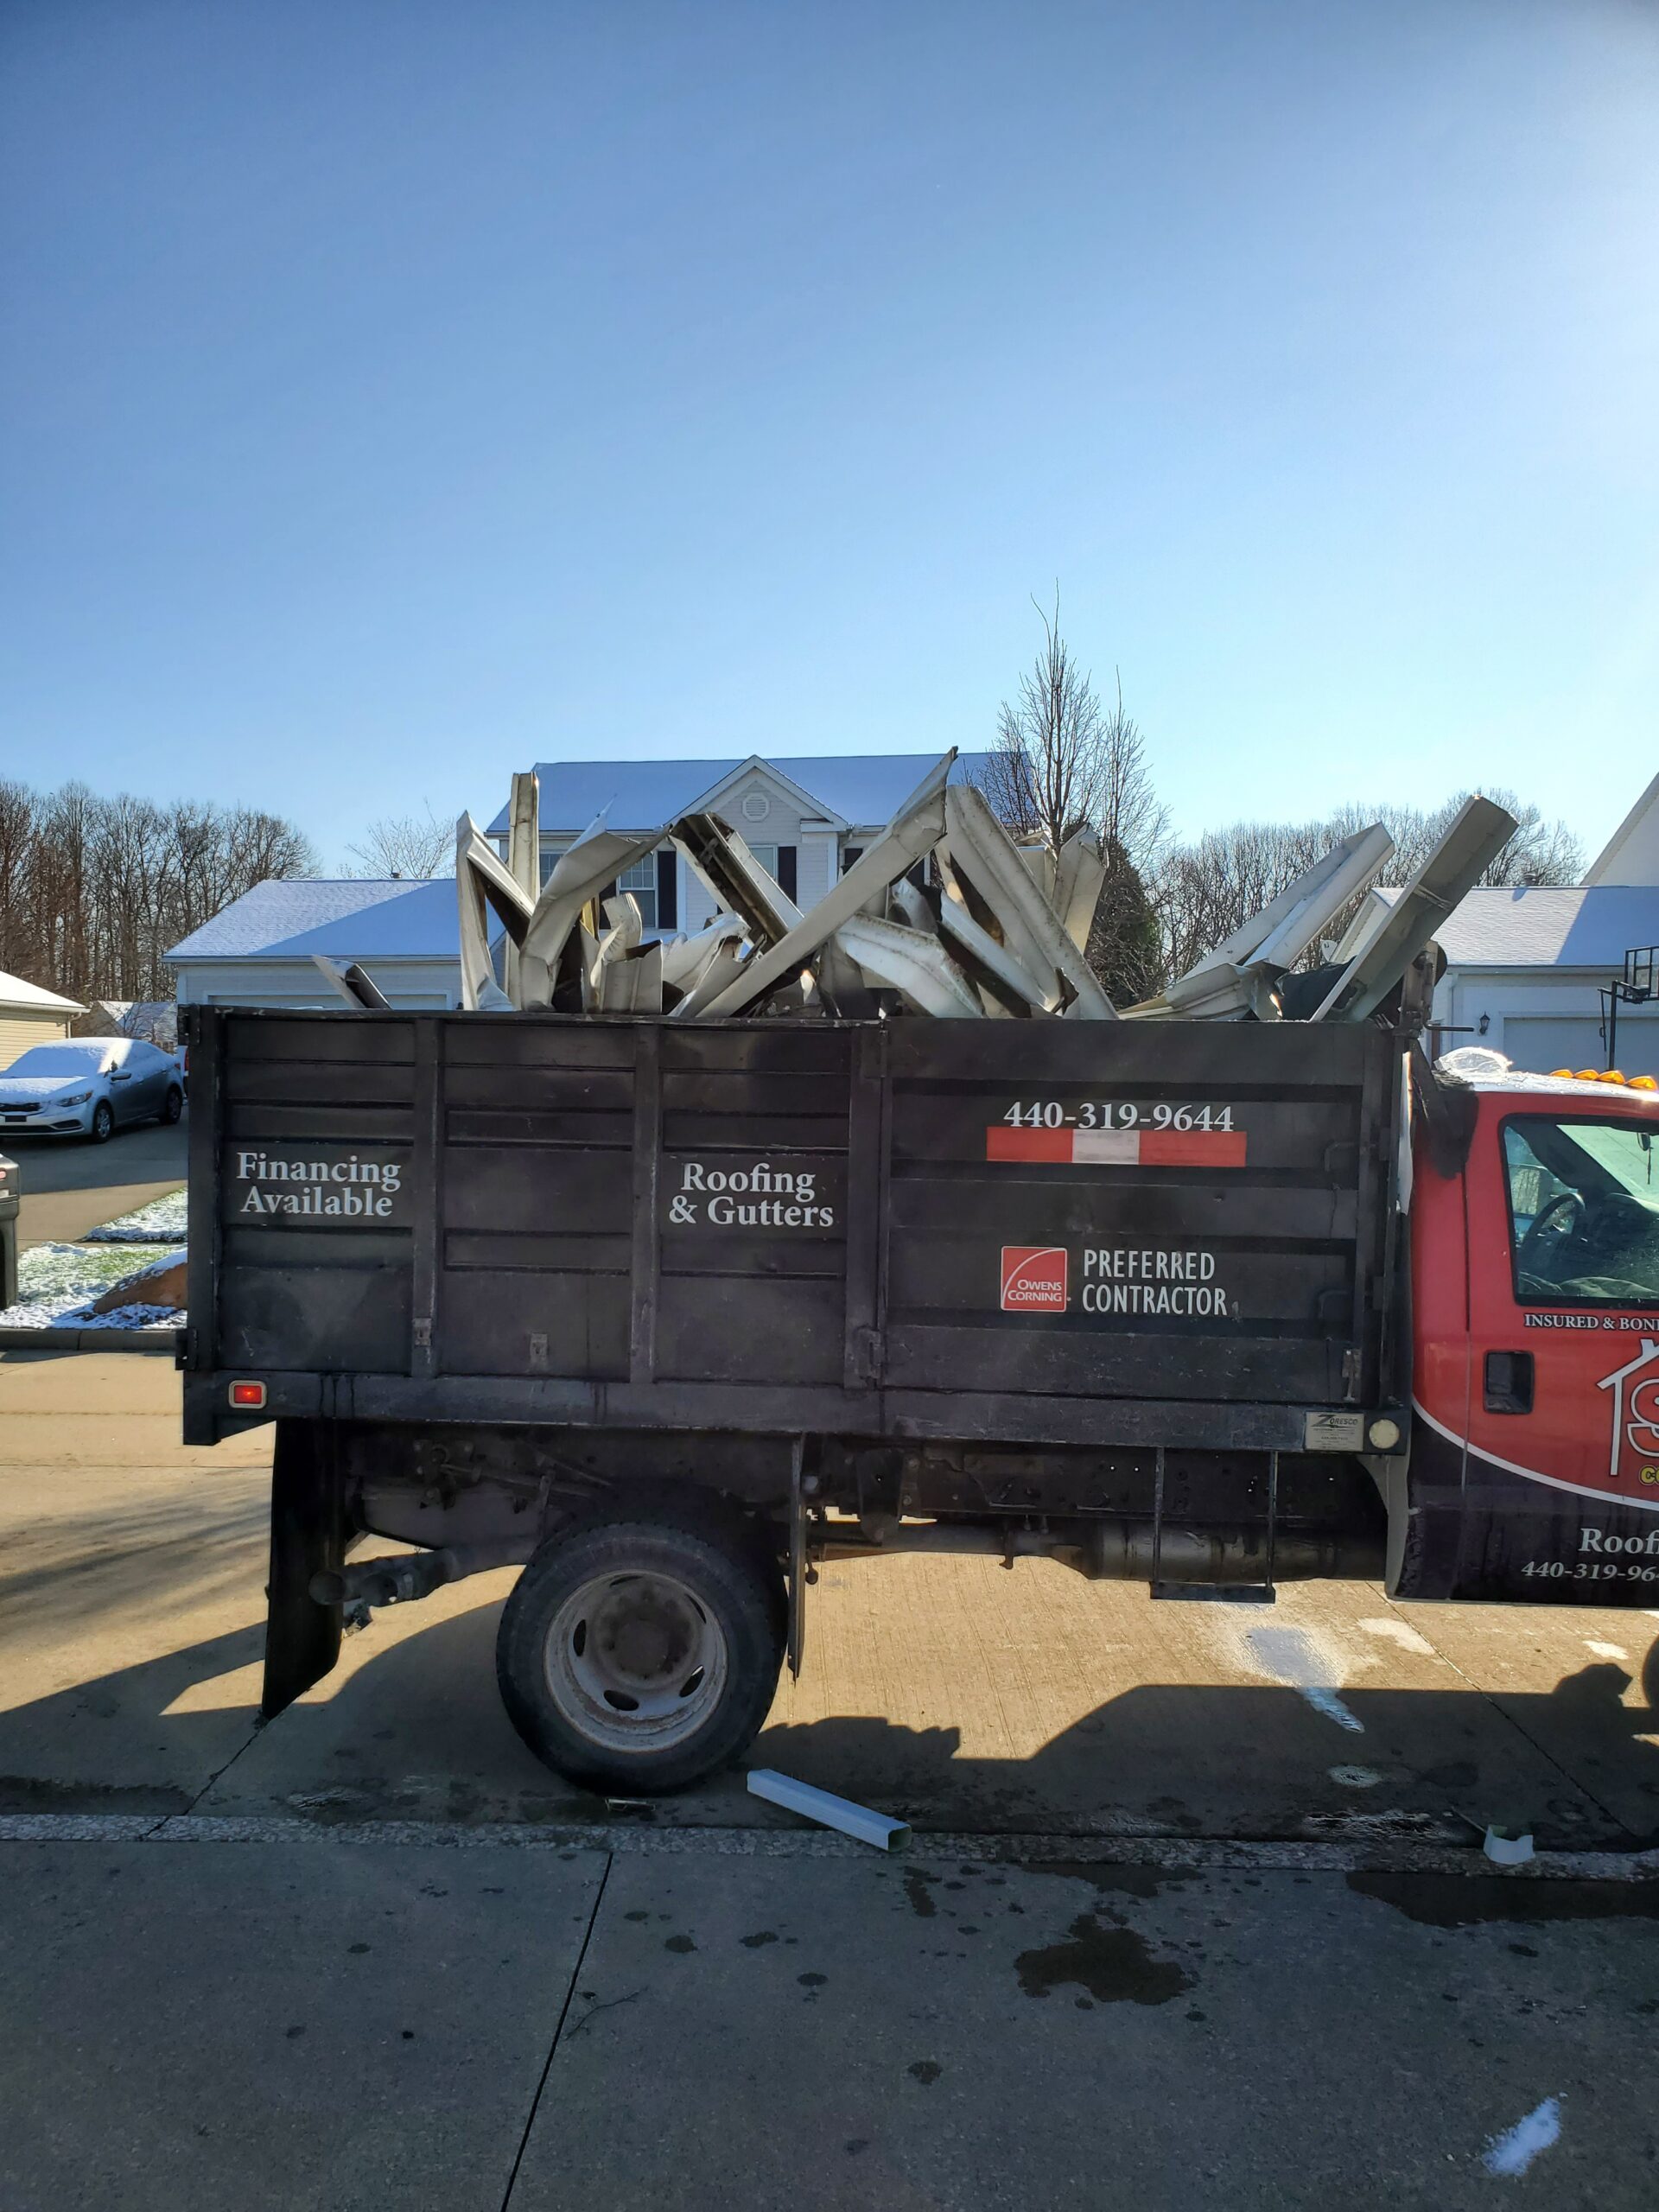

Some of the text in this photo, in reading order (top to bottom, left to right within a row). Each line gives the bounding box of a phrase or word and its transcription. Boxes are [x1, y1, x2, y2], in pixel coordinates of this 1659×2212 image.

[1003, 1101, 1234, 1132] 440-319-9644
[236, 1152, 402, 1192] Financing
[681, 1162, 816, 1203] Roofing
[240, 1185, 393, 1217] Available
[669, 1195, 834, 1227] & Gutters
[1084, 1249, 1215, 1281] PREFERRED
[1007, 1289, 1062, 1302] CORNING
[1017, 1279, 1062, 1291] OWENS
[1082, 1283, 1227, 1316] CONTRACTOR
[1524, 1313, 1599, 1329] INSURED
[1602, 1316, 1615, 1330] &
[1311, 1414, 1358, 1427] ZORESCO
[1521, 1560, 1659, 1582] 440-319-96
